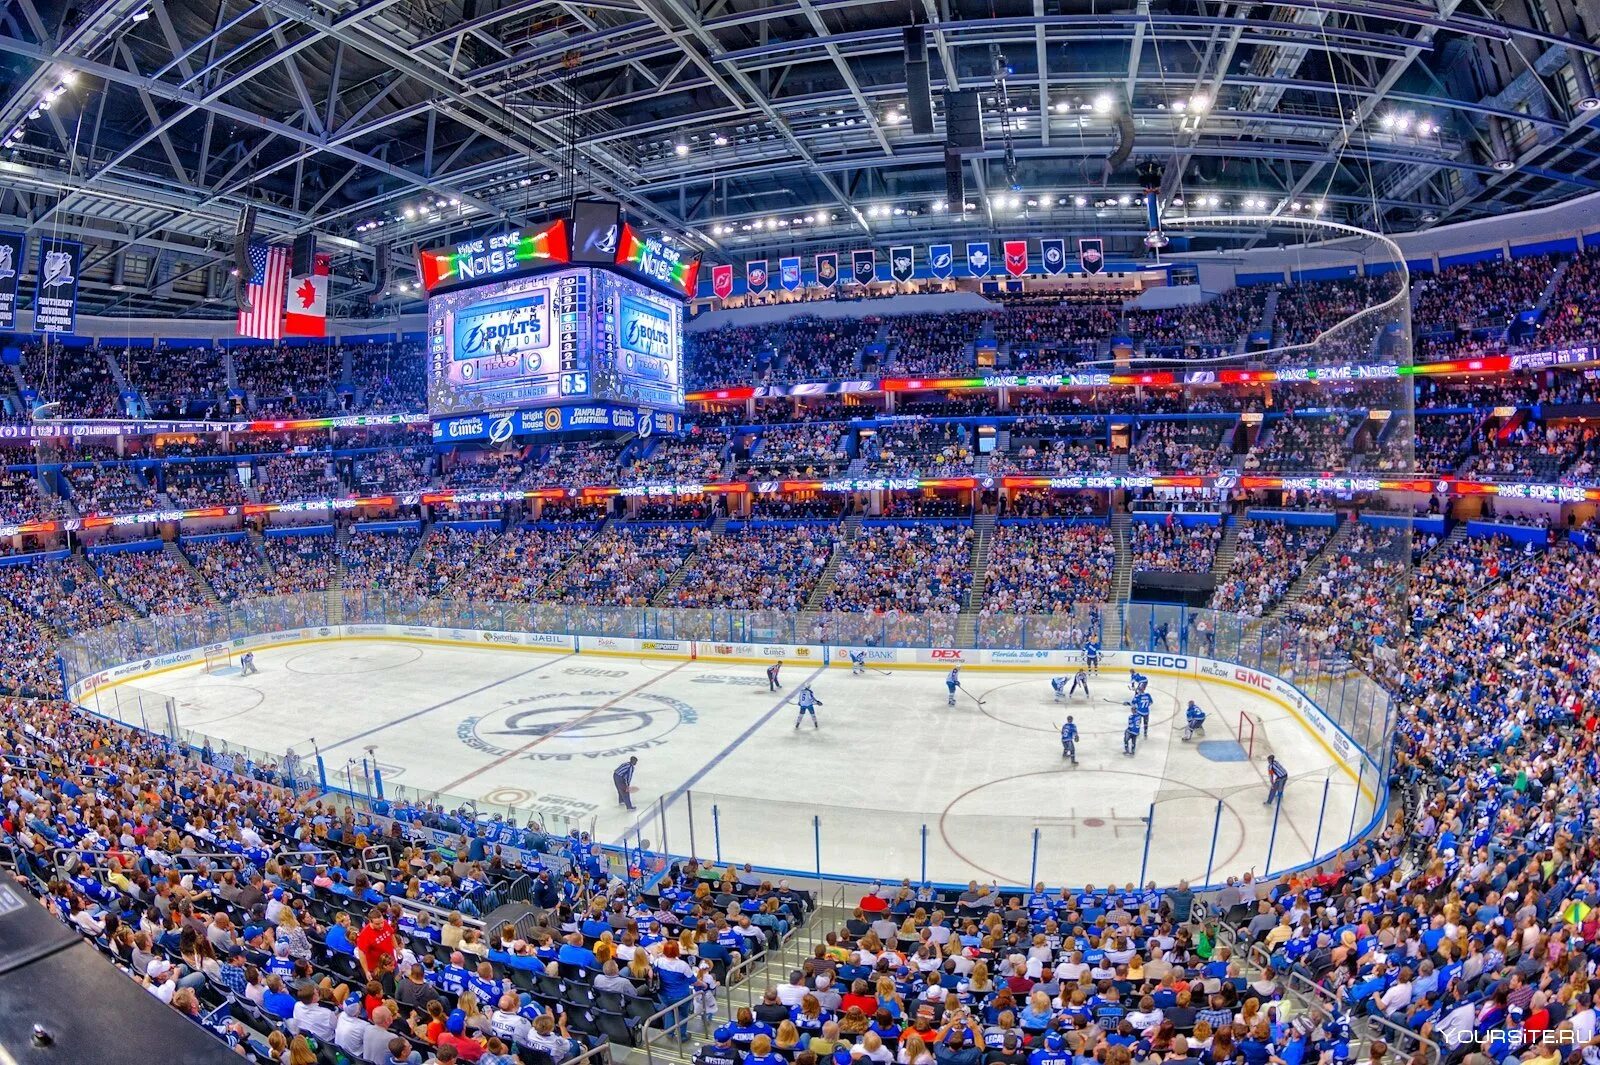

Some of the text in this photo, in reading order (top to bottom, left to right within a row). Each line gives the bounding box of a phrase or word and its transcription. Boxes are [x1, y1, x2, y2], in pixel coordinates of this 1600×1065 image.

[457, 231, 521, 255] MAKE SOME
[457, 250, 519, 280] NOISE
[639, 254, 673, 283] NOISE
[38, 297, 74, 307] SOUTHEAST
[41, 307, 69, 316] DIVISION
[37, 316, 72, 325] CHAMPIONS
[486, 319, 541, 341] BOLTS
[640, 325, 669, 345] BOLTS
[484, 360, 516, 371] TECO
[1317, 367, 1351, 379] SOME
[1360, 366, 1399, 378] NOISE
[561, 373, 586, 394] 6.5
[1028, 376, 1063, 386] SOME
[1070, 374, 1110, 385] NOISE
[522, 411, 543, 422] bright
[574, 408, 595, 416] TAMPA
[596, 408, 607, 416] BAY
[522, 420, 543, 430] house
[570, 416, 609, 425] LIGHTNING
[90, 425, 120, 435] LIGHTNING
[448, 421, 483, 438] Times
[857, 480, 884, 490] SOME
[889, 479, 918, 490] NOISE
[1087, 477, 1115, 488] SOME
[1121, 477, 1152, 488] NOISE
[1316, 478, 1345, 490] SOME
[1351, 478, 1380, 490] NOISE
[676, 485, 704, 494] NOISE
[1530, 485, 1555, 499] SOME
[1559, 487, 1585, 501] NOISE
[532, 635, 563, 643] JABIL
[763, 646, 785, 655] Times
[868, 650, 893, 659] BANK
[931, 650, 962, 659] DEX
[1132, 655, 1188, 669] GEICO
[1201, 666, 1229, 678] NHL.COM
[84, 672, 110, 690] GMC
[1235, 669, 1273, 691] GMC
[503, 692, 568, 706] TAMPA
[1140, 699, 1150, 708] 77
[582, 739, 668, 759] TAMPA
[298, 781, 308, 791] 80
[705, 1056, 734, 1065] NYSTROM
